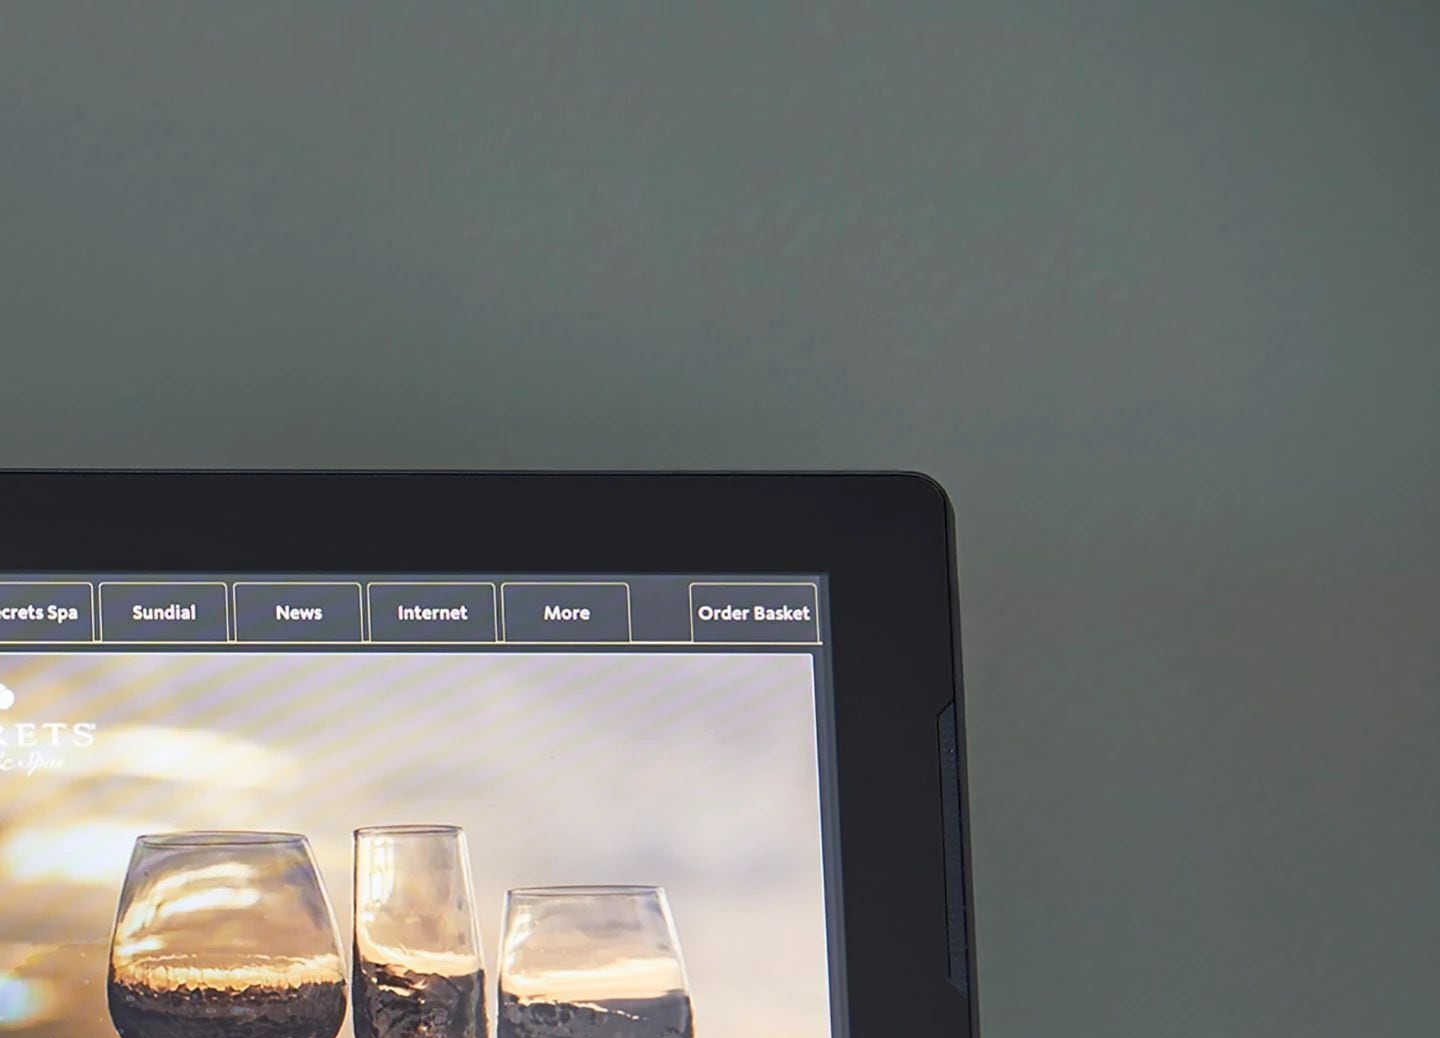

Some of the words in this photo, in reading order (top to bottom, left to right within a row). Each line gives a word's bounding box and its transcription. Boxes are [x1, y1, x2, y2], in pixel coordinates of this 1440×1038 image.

[47, 604, 79, 625] Spa
[131, 604, 196, 622] Sundial
[275, 605, 323, 622] News
[397, 605, 468, 622] Internet
[543, 605, 591, 622] More
[697, 605, 750, 623] Order
[755, 605, 811, 623] Basket
[18, 751, 64, 776] Spas
